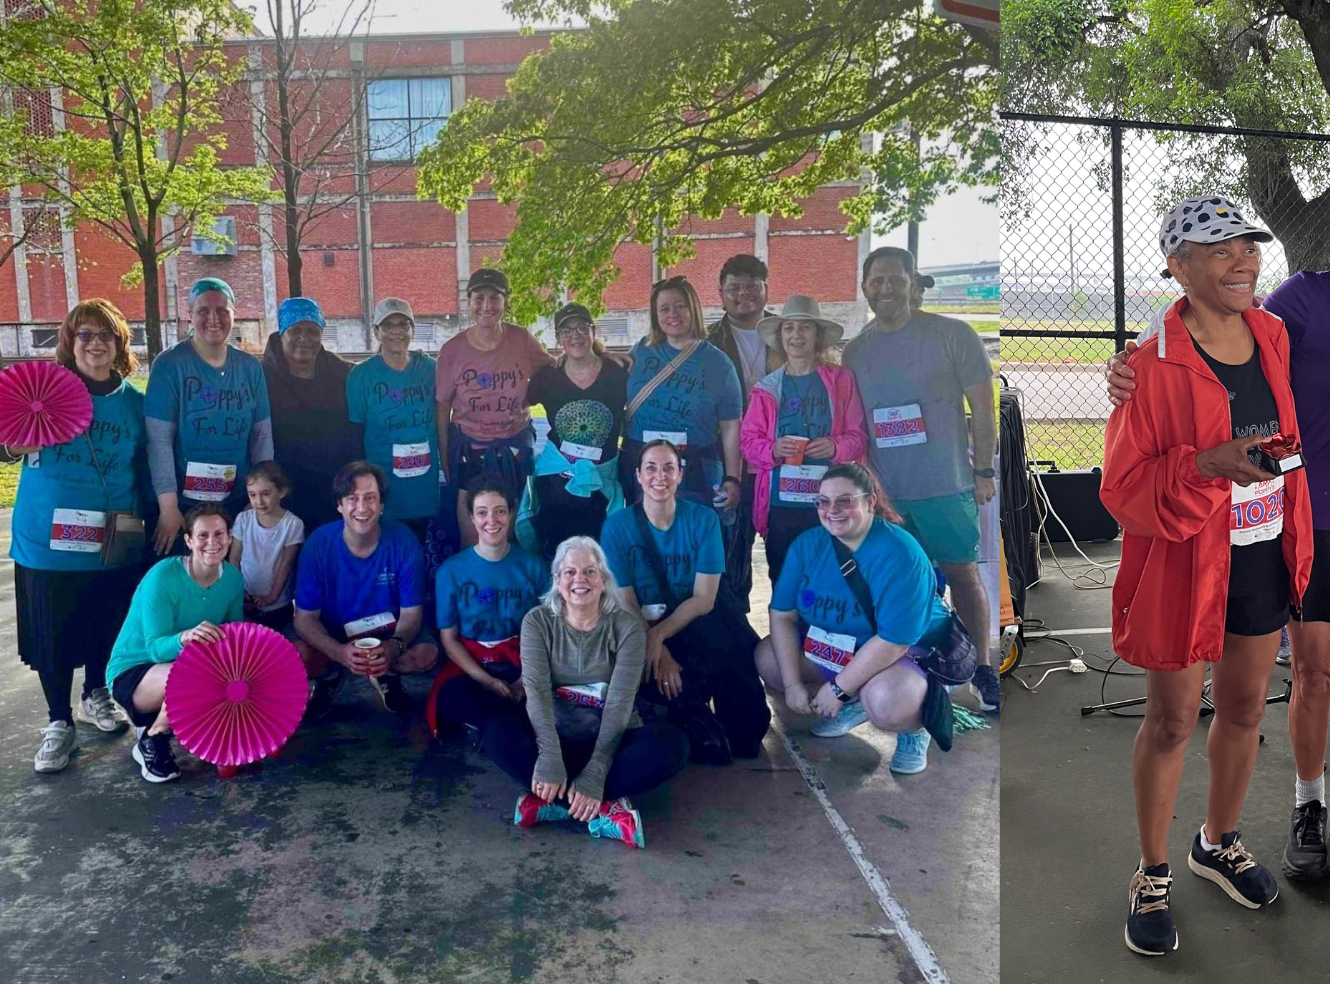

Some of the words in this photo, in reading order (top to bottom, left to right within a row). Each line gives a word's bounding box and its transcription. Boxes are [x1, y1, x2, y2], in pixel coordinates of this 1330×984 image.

[468, 396, 491, 412] For
[664, 396, 692, 418] Life
[192, 417, 218, 438] For
[384, 414, 406, 433] For
[879, 419, 920, 437] 1382
[785, 478, 820, 493] 260
[60, 523, 98, 540] 322
[811, 640, 846, 664] 247
